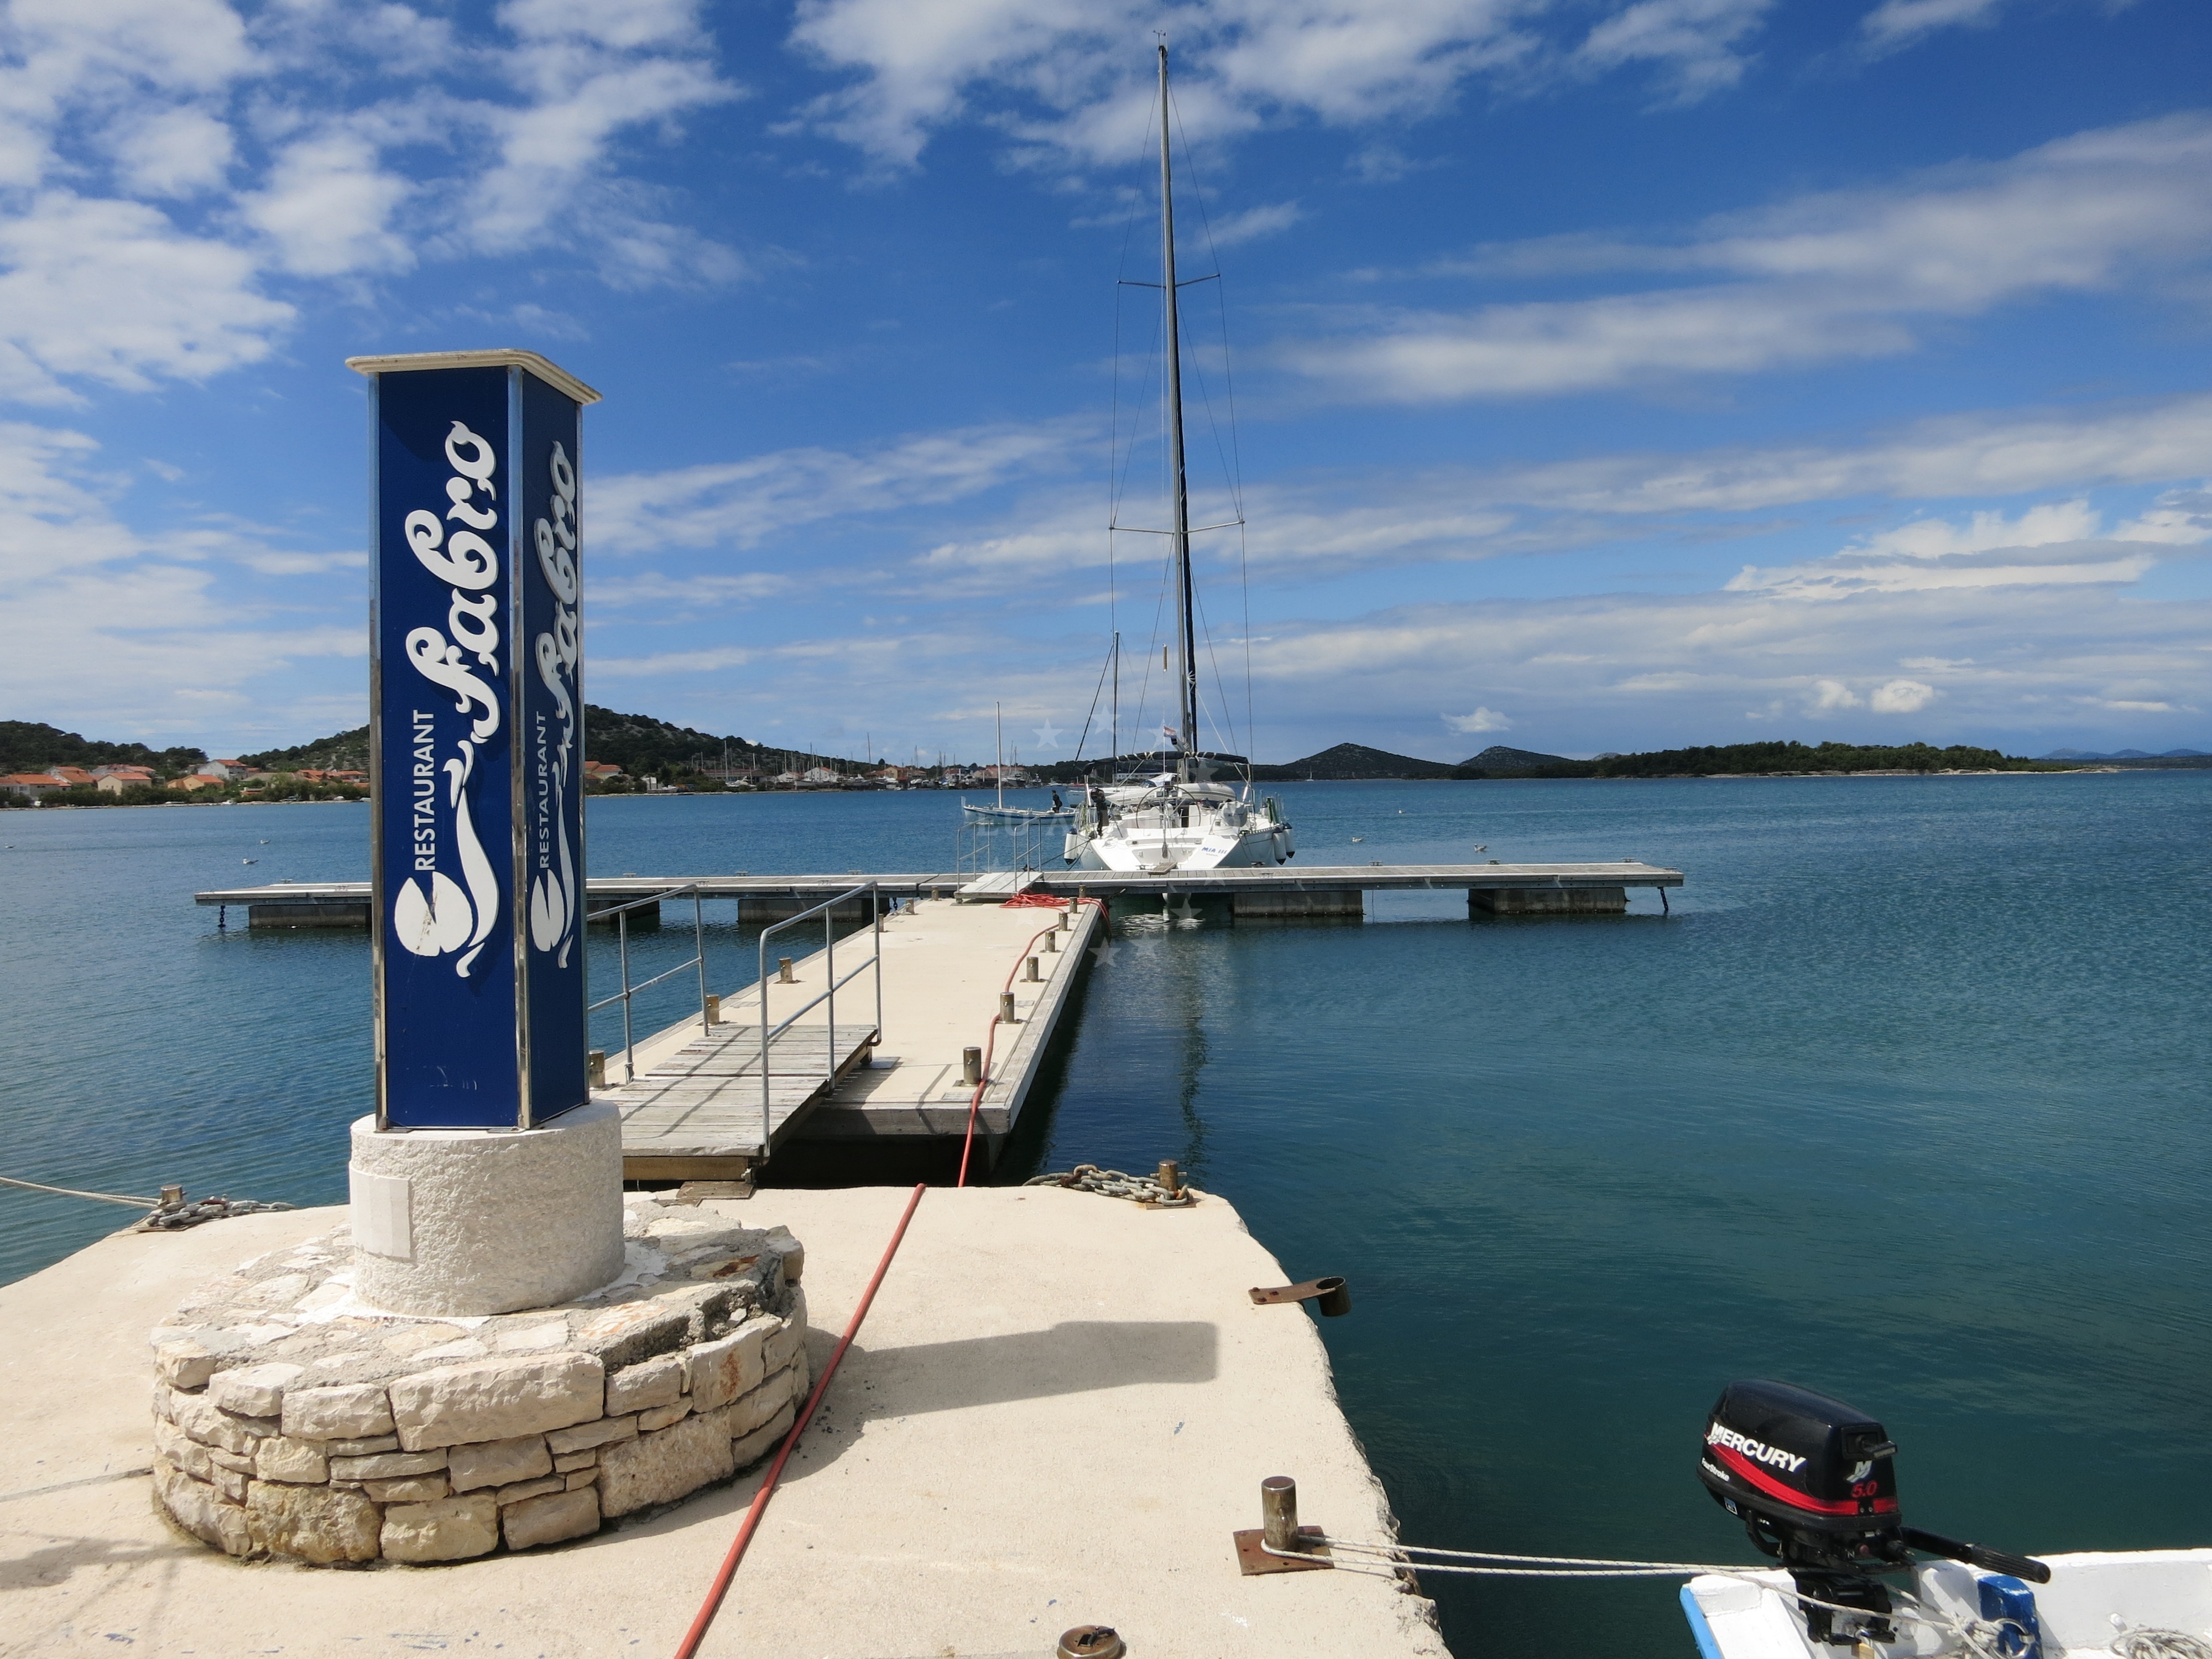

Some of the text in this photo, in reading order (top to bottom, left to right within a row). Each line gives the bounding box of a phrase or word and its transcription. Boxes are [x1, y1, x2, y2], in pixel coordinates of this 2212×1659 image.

[413, 709, 435, 871] RESTAURANT
[536, 711, 549, 869] RESTAURANT
[1702, 1457, 1730, 1481] FourStroke
[1707, 1422, 1806, 1473] MERCURY
[1851, 1480, 1878, 1498] 5.0
